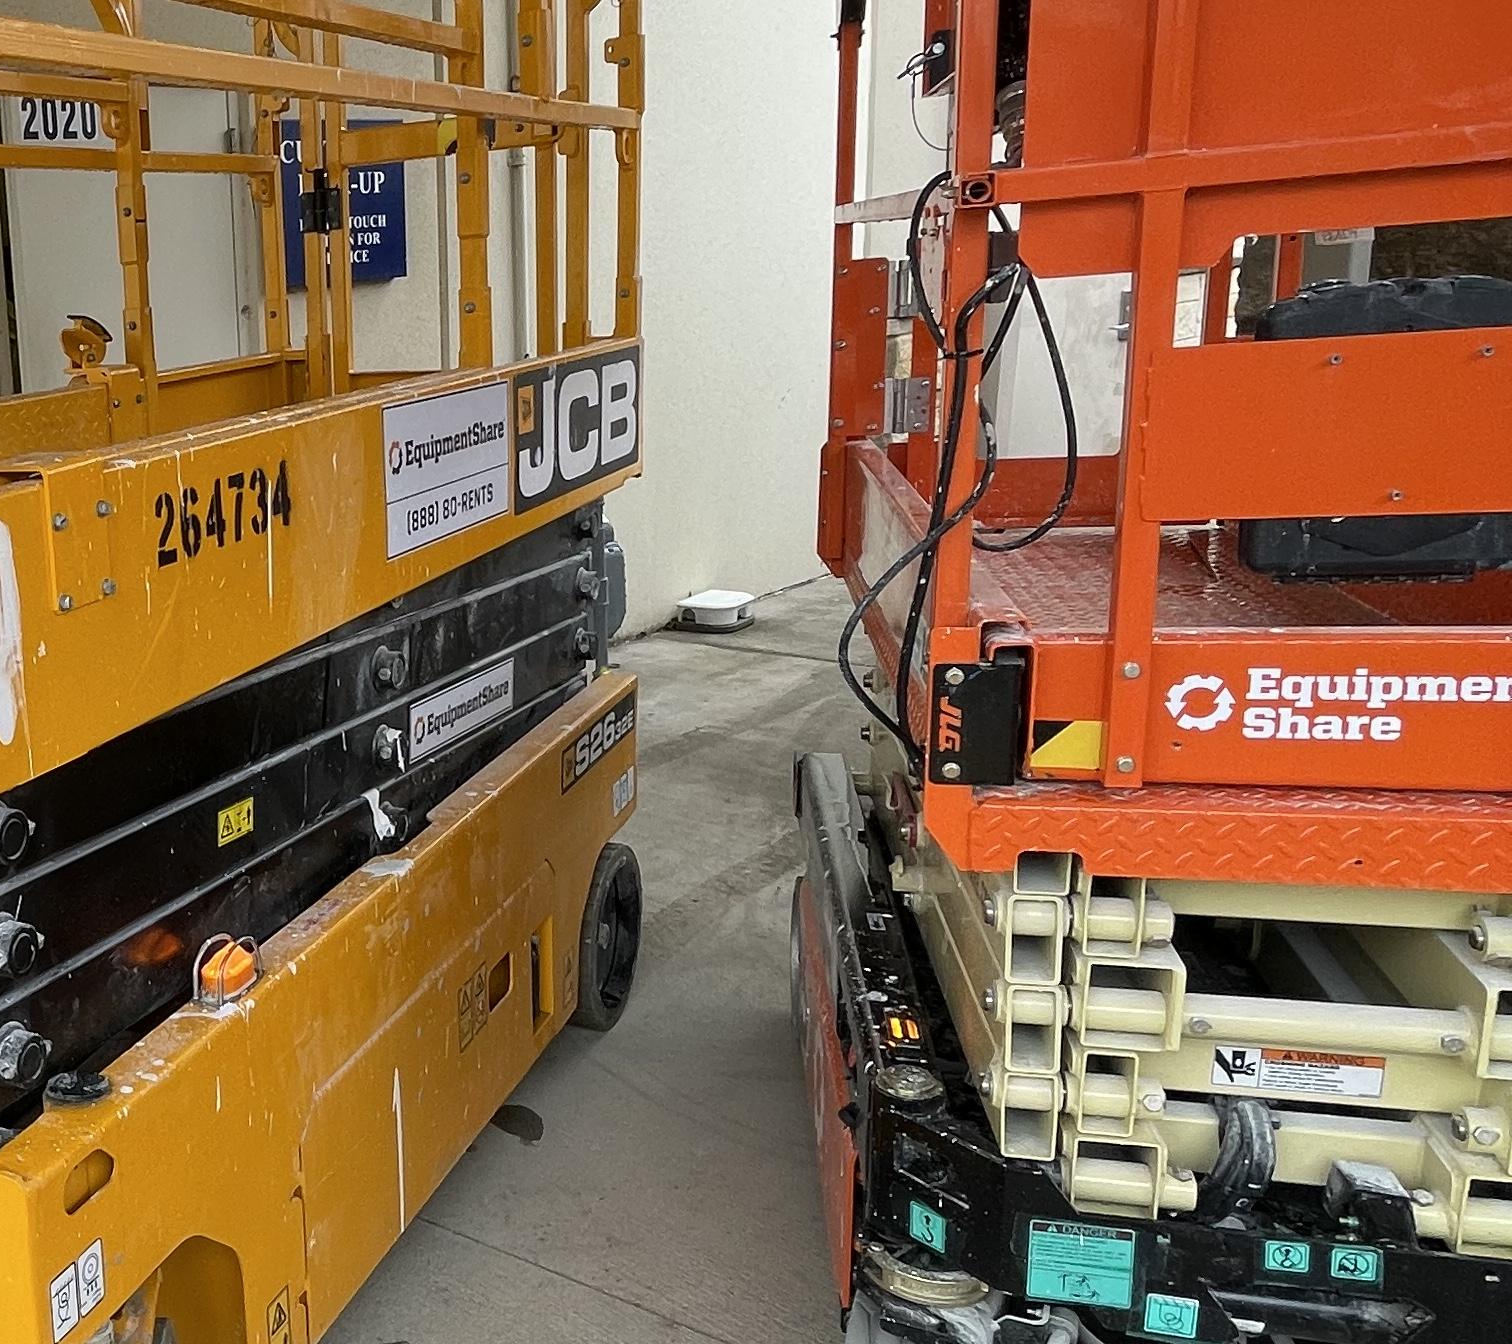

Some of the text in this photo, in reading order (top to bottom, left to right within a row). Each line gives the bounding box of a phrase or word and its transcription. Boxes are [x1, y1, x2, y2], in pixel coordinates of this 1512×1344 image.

[21, 97, 97, 141] 2020
[357, 232, 381, 246] FOR
[405, 420, 506, 469] EquipmentShare
[518, 359, 638, 498] JCB
[155, 459, 292, 569] 264734
[406, 482, 494, 536] (888) 80-RENTS
[426, 679, 510, 736] EquipmentShare
[939, 696, 963, 753] JLG
[1241, 707, 1402, 741] Share
[1062, 1224, 1117, 1238] DANGER
